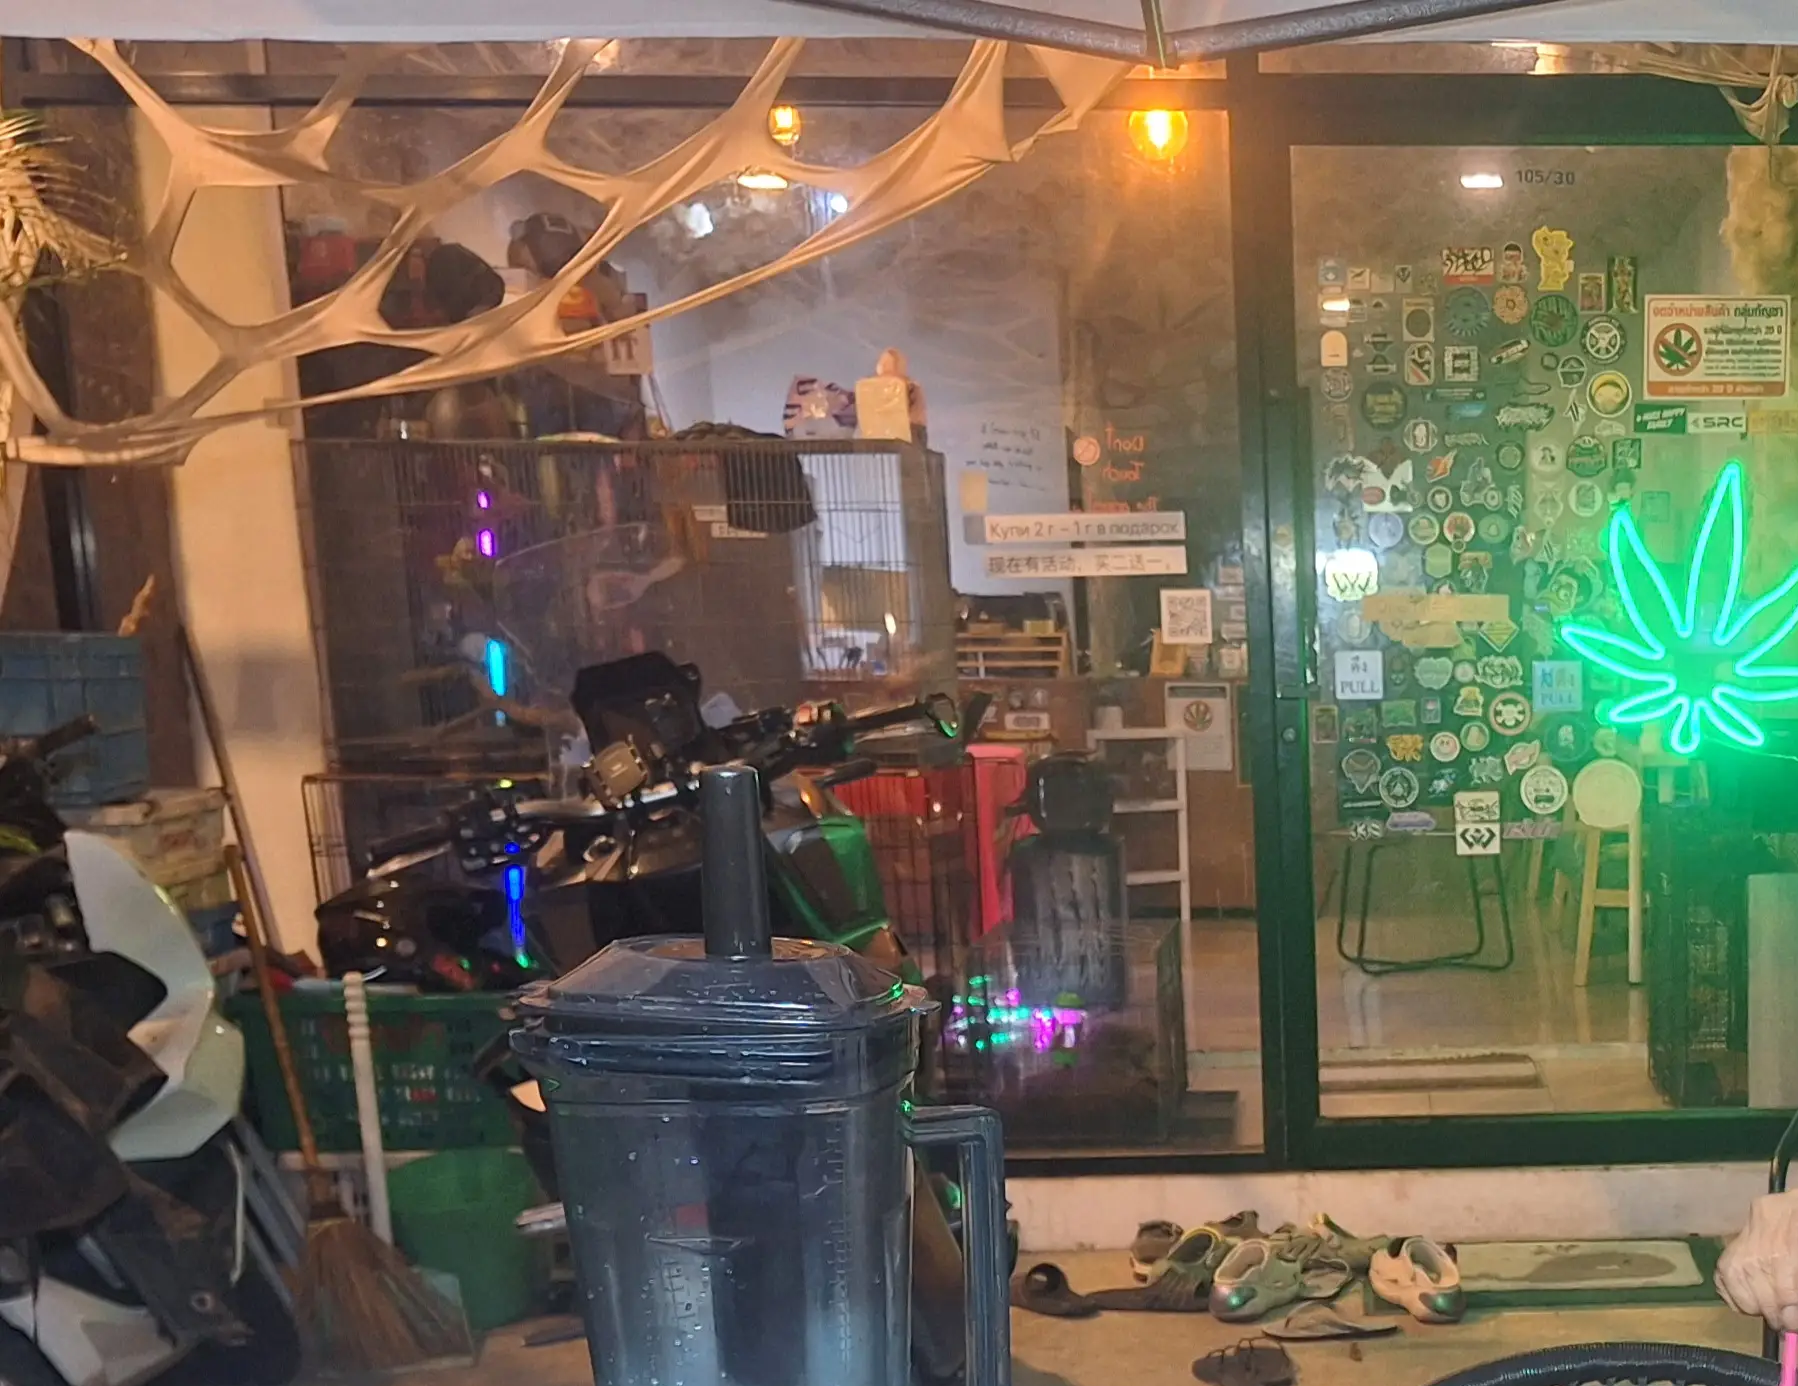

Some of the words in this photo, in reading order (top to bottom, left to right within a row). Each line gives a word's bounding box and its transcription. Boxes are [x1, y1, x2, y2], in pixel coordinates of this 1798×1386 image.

[1515, 168, 1575, 185] 105/30
[1703, 416, 1744, 429] SRC
[1340, 680, 1380, 694] PULL
